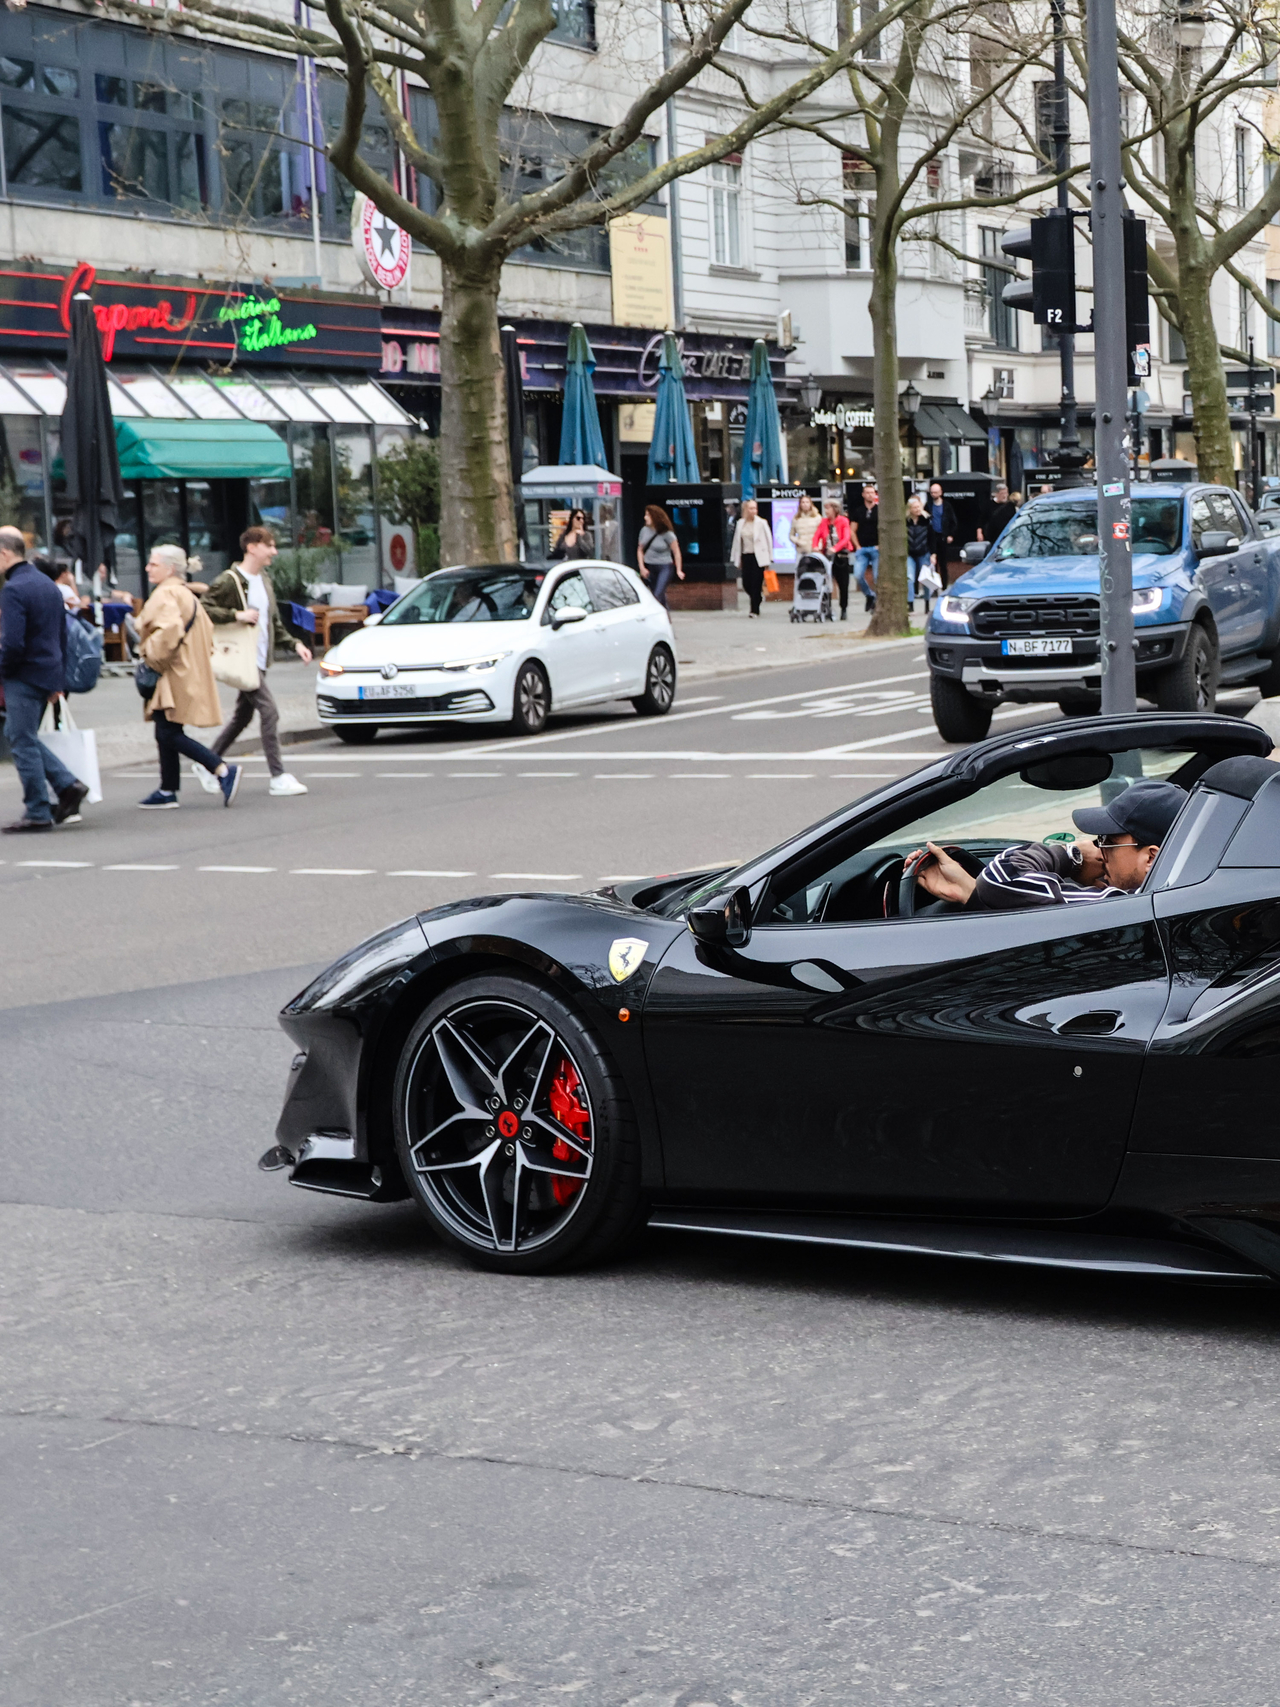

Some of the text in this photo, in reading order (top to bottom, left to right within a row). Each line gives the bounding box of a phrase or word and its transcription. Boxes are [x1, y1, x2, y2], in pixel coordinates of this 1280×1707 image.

[1047, 308, 1063, 323] F2
[978, 608, 1100, 624] FORD
[1009, 641, 1070, 653] N BF 7177
